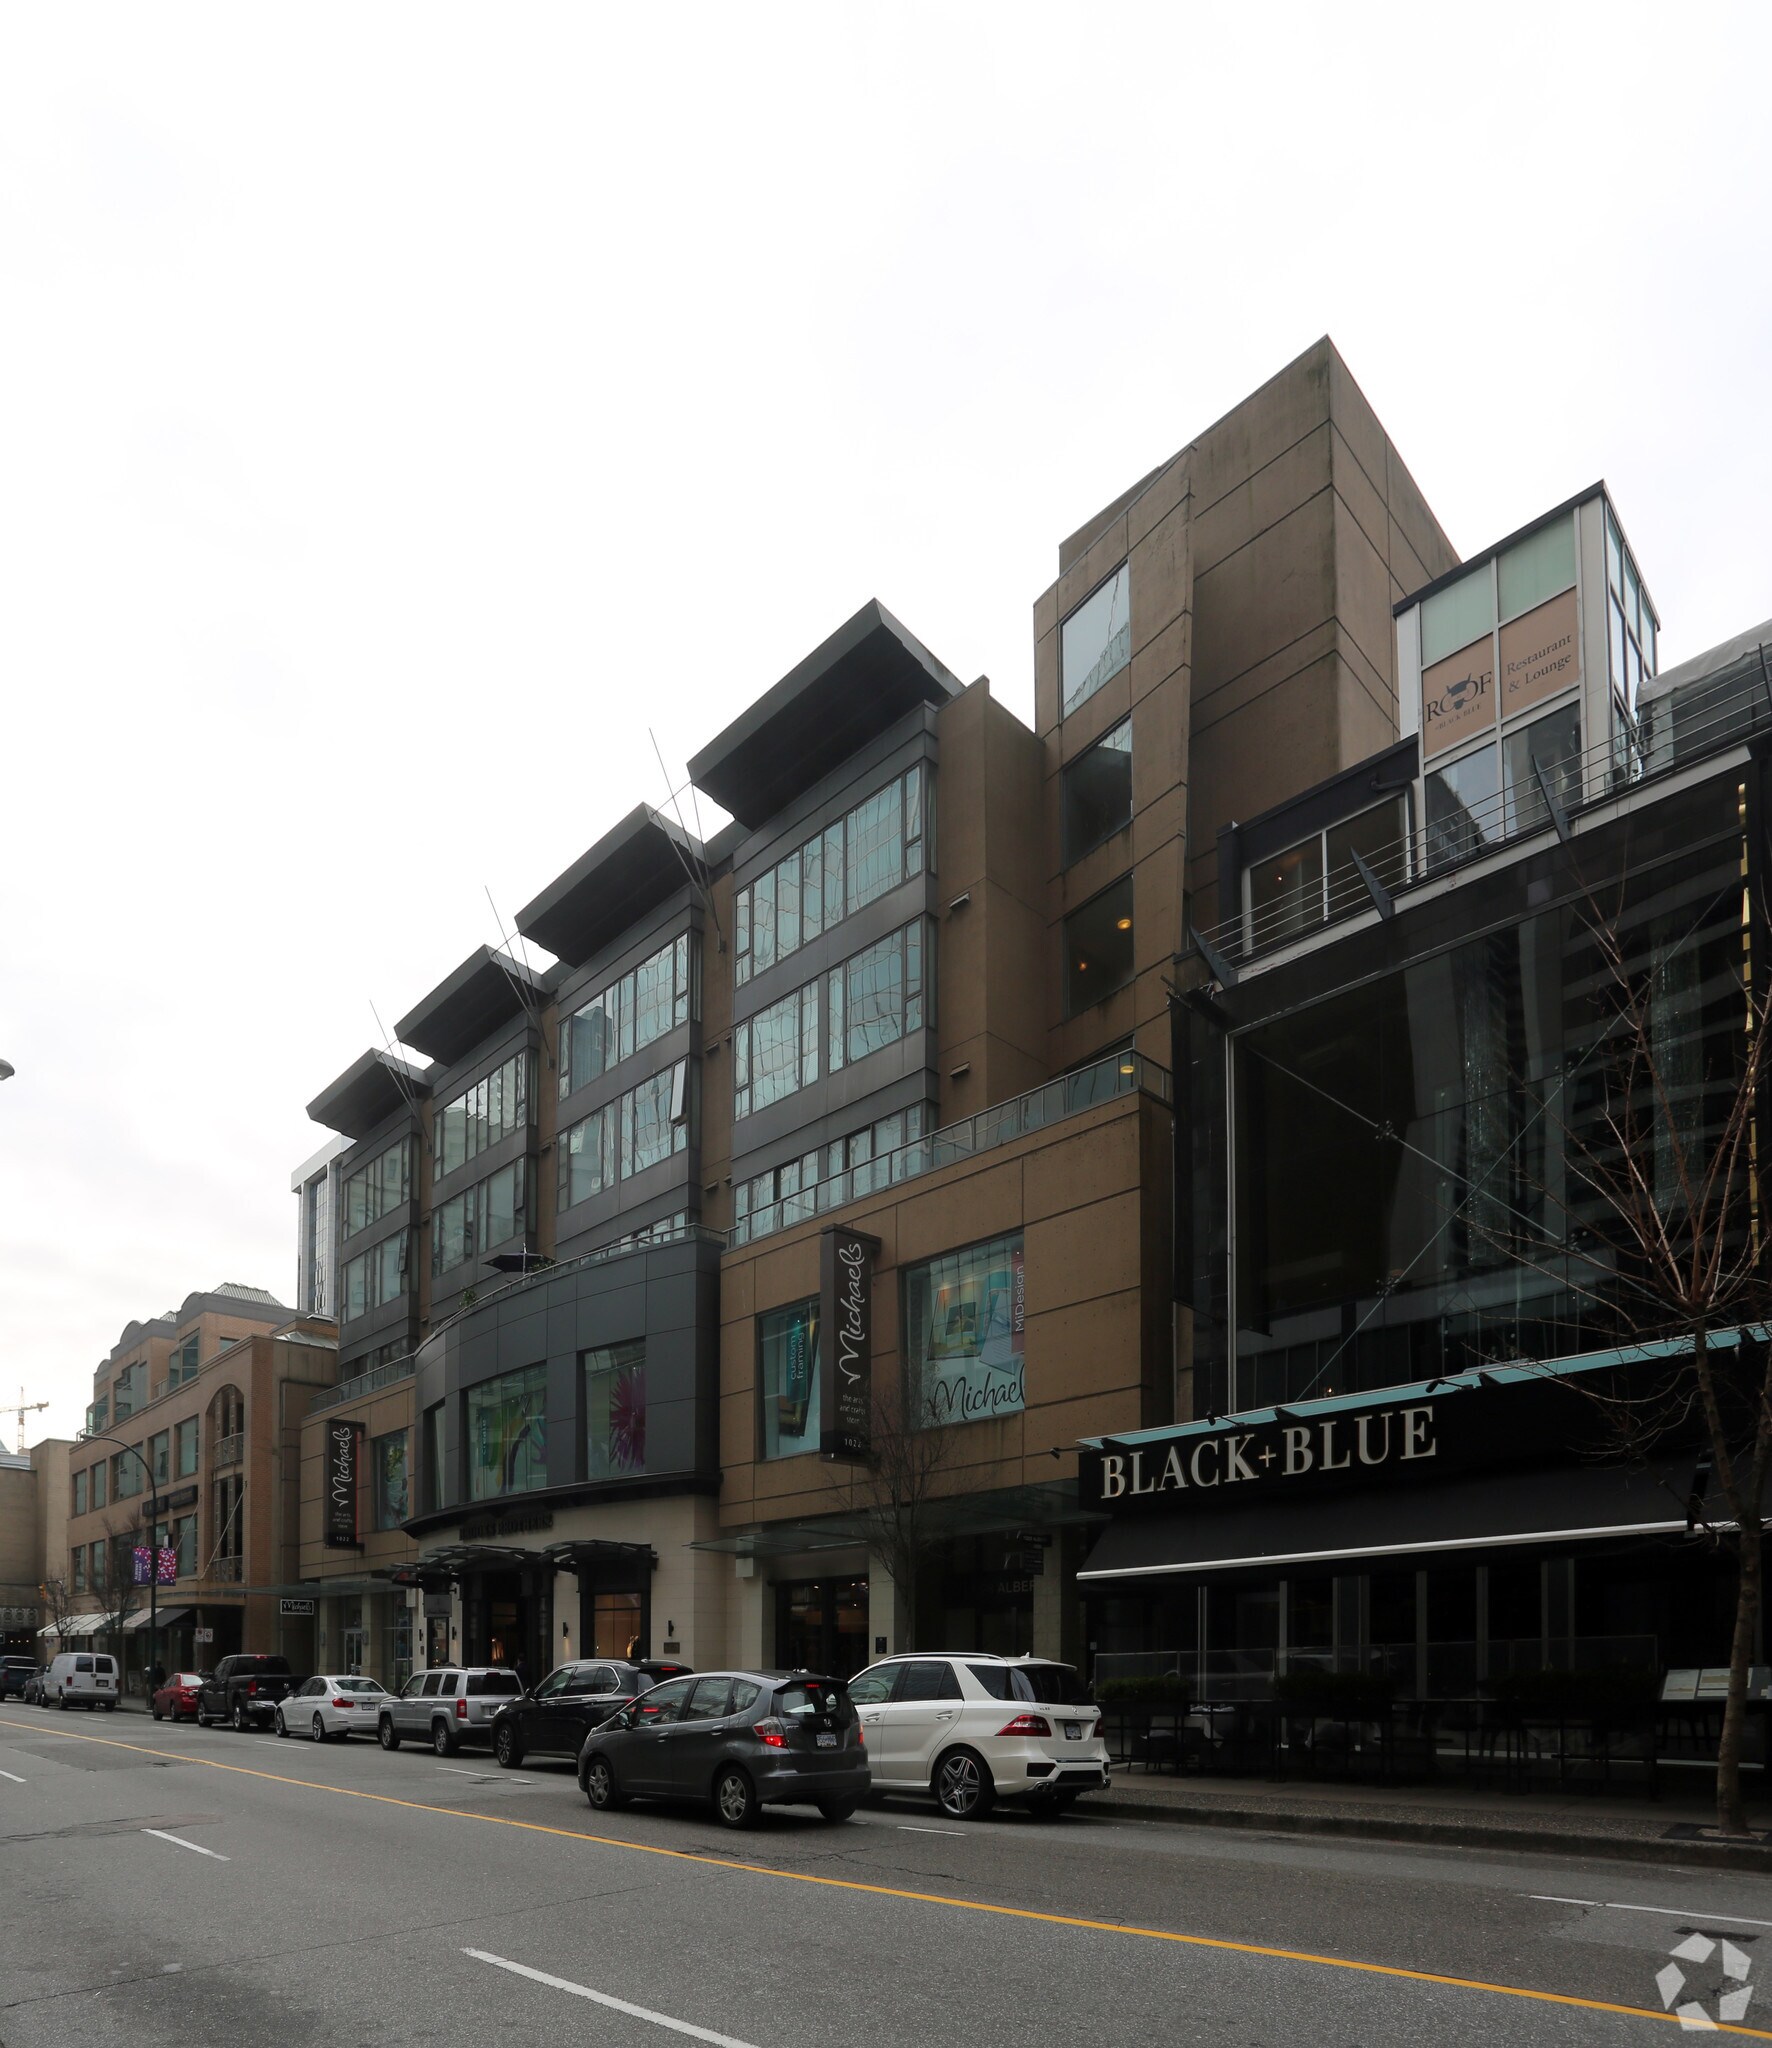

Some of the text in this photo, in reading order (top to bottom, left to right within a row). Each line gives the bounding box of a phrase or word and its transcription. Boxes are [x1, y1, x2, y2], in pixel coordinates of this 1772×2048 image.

[1507, 635, 1572, 675] Restaurant
[1509, 654, 1571, 693] & Lounge
[1427, 671, 1492, 723] ROOF
[838, 1242, 865, 1386] Michaels
[1014, 1265, 1025, 1332] MiDesign
[797, 1332, 805, 1379] framing
[331, 1427, 353, 1507] Michaels
[844, 1438, 862, 1448] 1022
[1100, 1404, 1437, 1500] BLACK+BLUE
